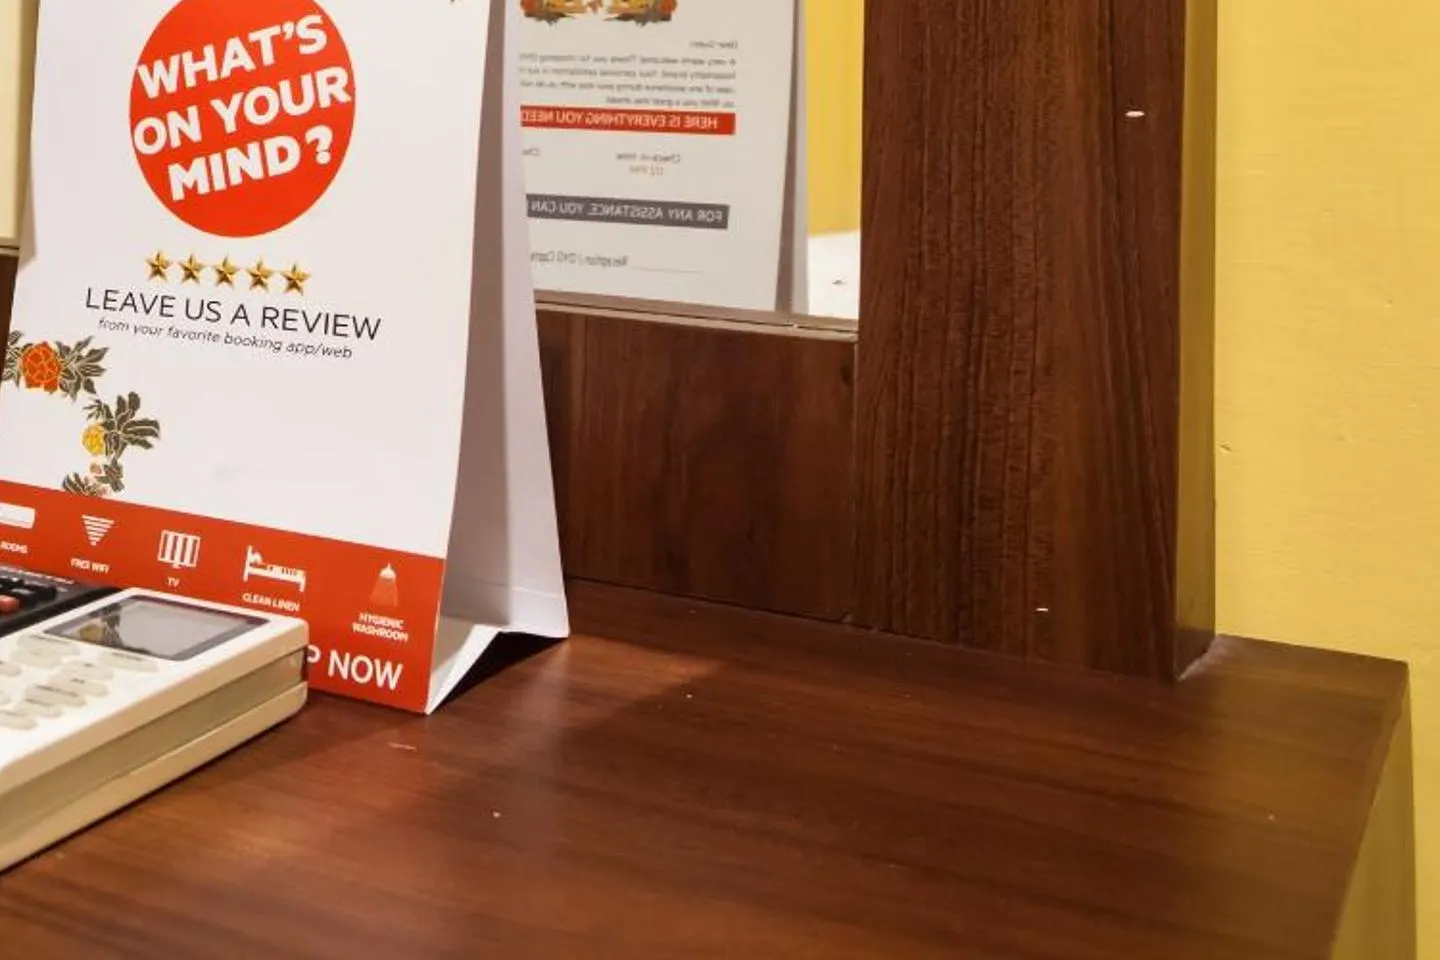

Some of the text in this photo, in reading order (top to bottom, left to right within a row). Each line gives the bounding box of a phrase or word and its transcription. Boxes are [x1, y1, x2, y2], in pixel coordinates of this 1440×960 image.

[138, 14, 327, 99] WHAT'S
[133, 66, 352, 156] ON YOUR
[85, 287, 382, 341] LEAVE US A REVIEW
[98, 318, 354, 359] from your favorite booking app/web
[0, 540, 29, 555] ROOMS
[70, 557, 91, 571] FREE
[166, 576, 181, 588] TV
[242, 592, 301, 613] CLEAN LINEN
[358, 611, 406, 631] HYGIENIC
[351, 622, 410, 642] WASHROOM
[327, 648, 405, 691] NOW
